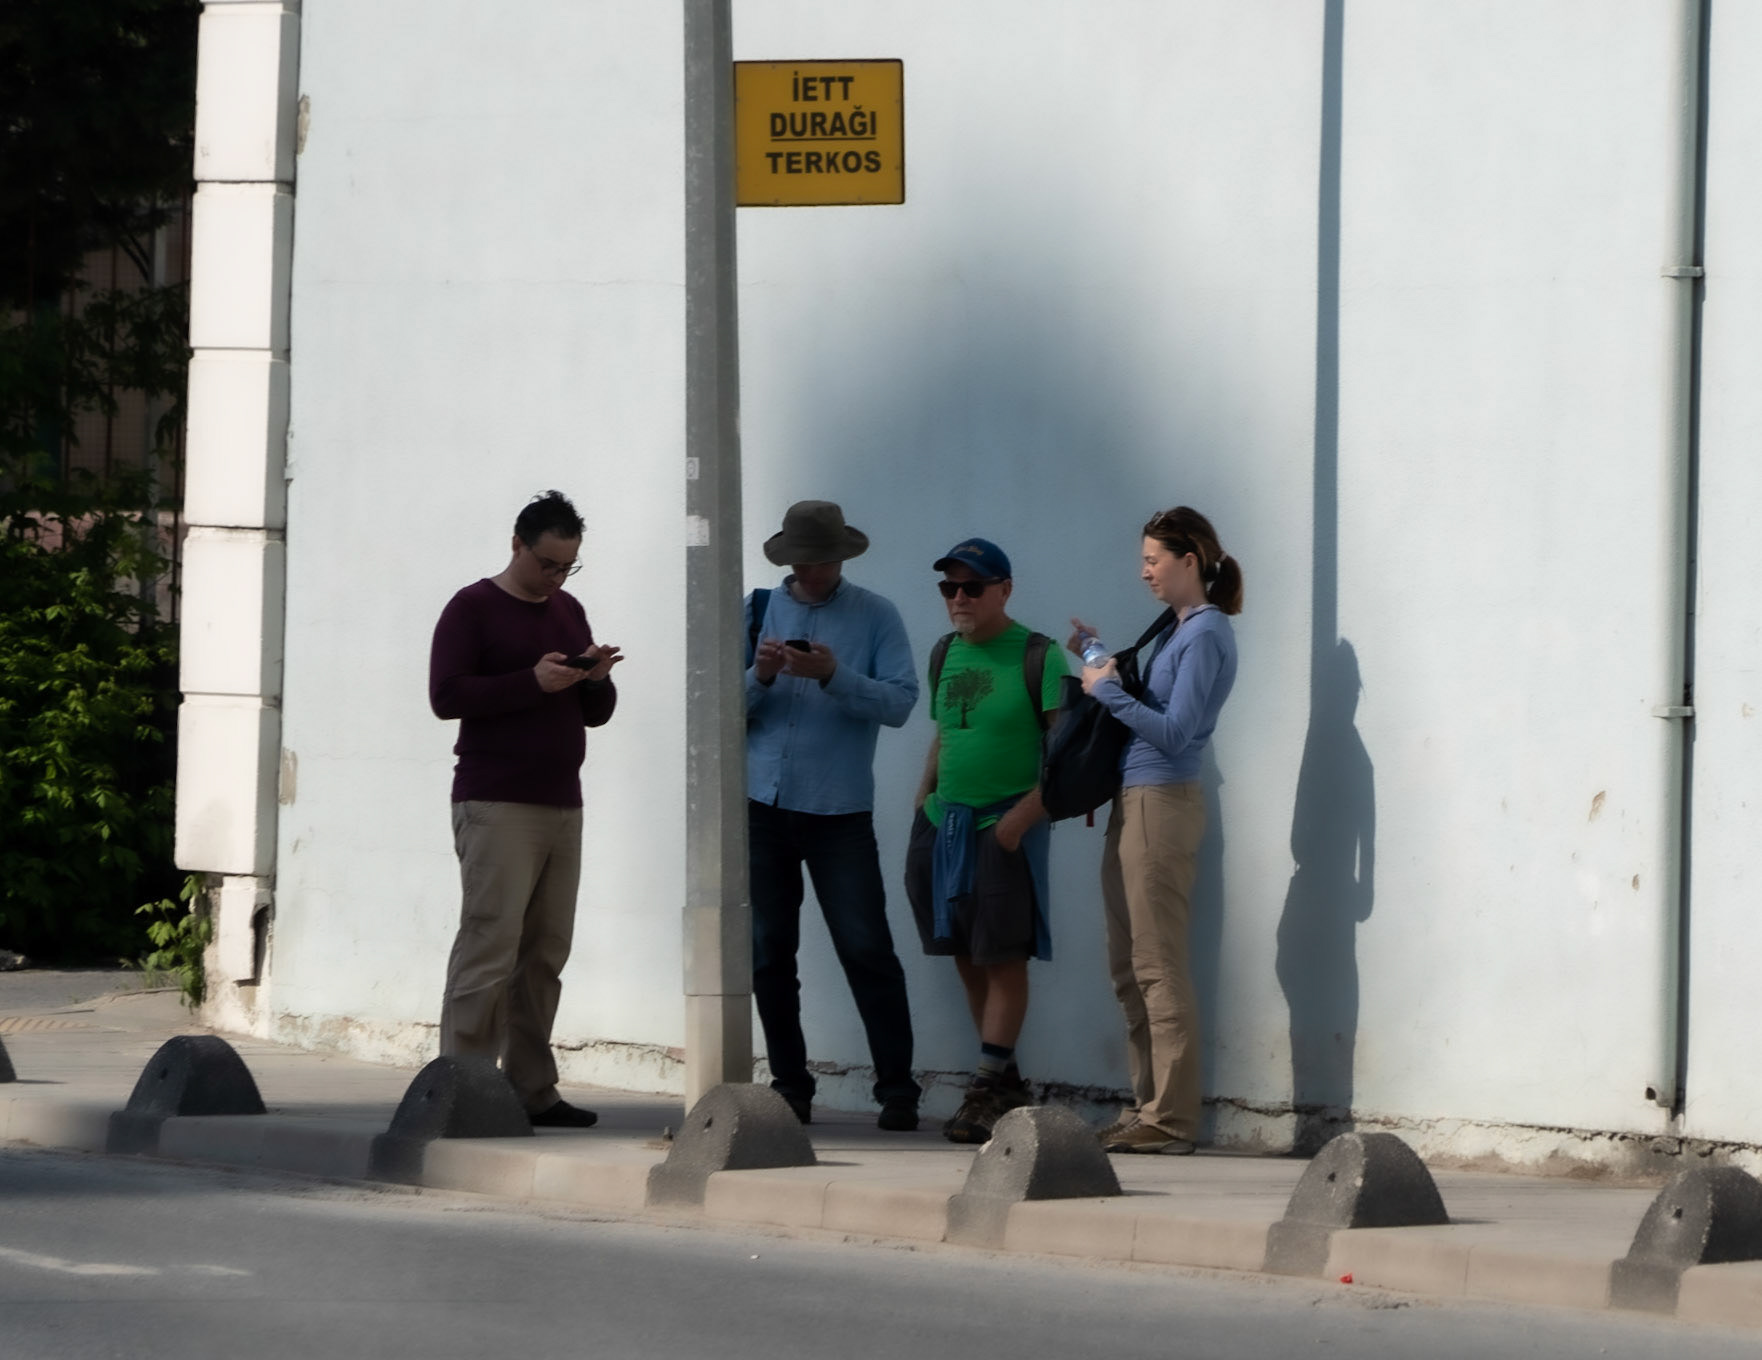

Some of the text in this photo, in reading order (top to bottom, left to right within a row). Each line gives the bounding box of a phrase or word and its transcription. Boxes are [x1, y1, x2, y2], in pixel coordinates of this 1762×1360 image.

[792, 71, 854, 101] İETT
[770, 105, 876, 137] DURAĞI
[765, 151, 881, 174] TERKOS
